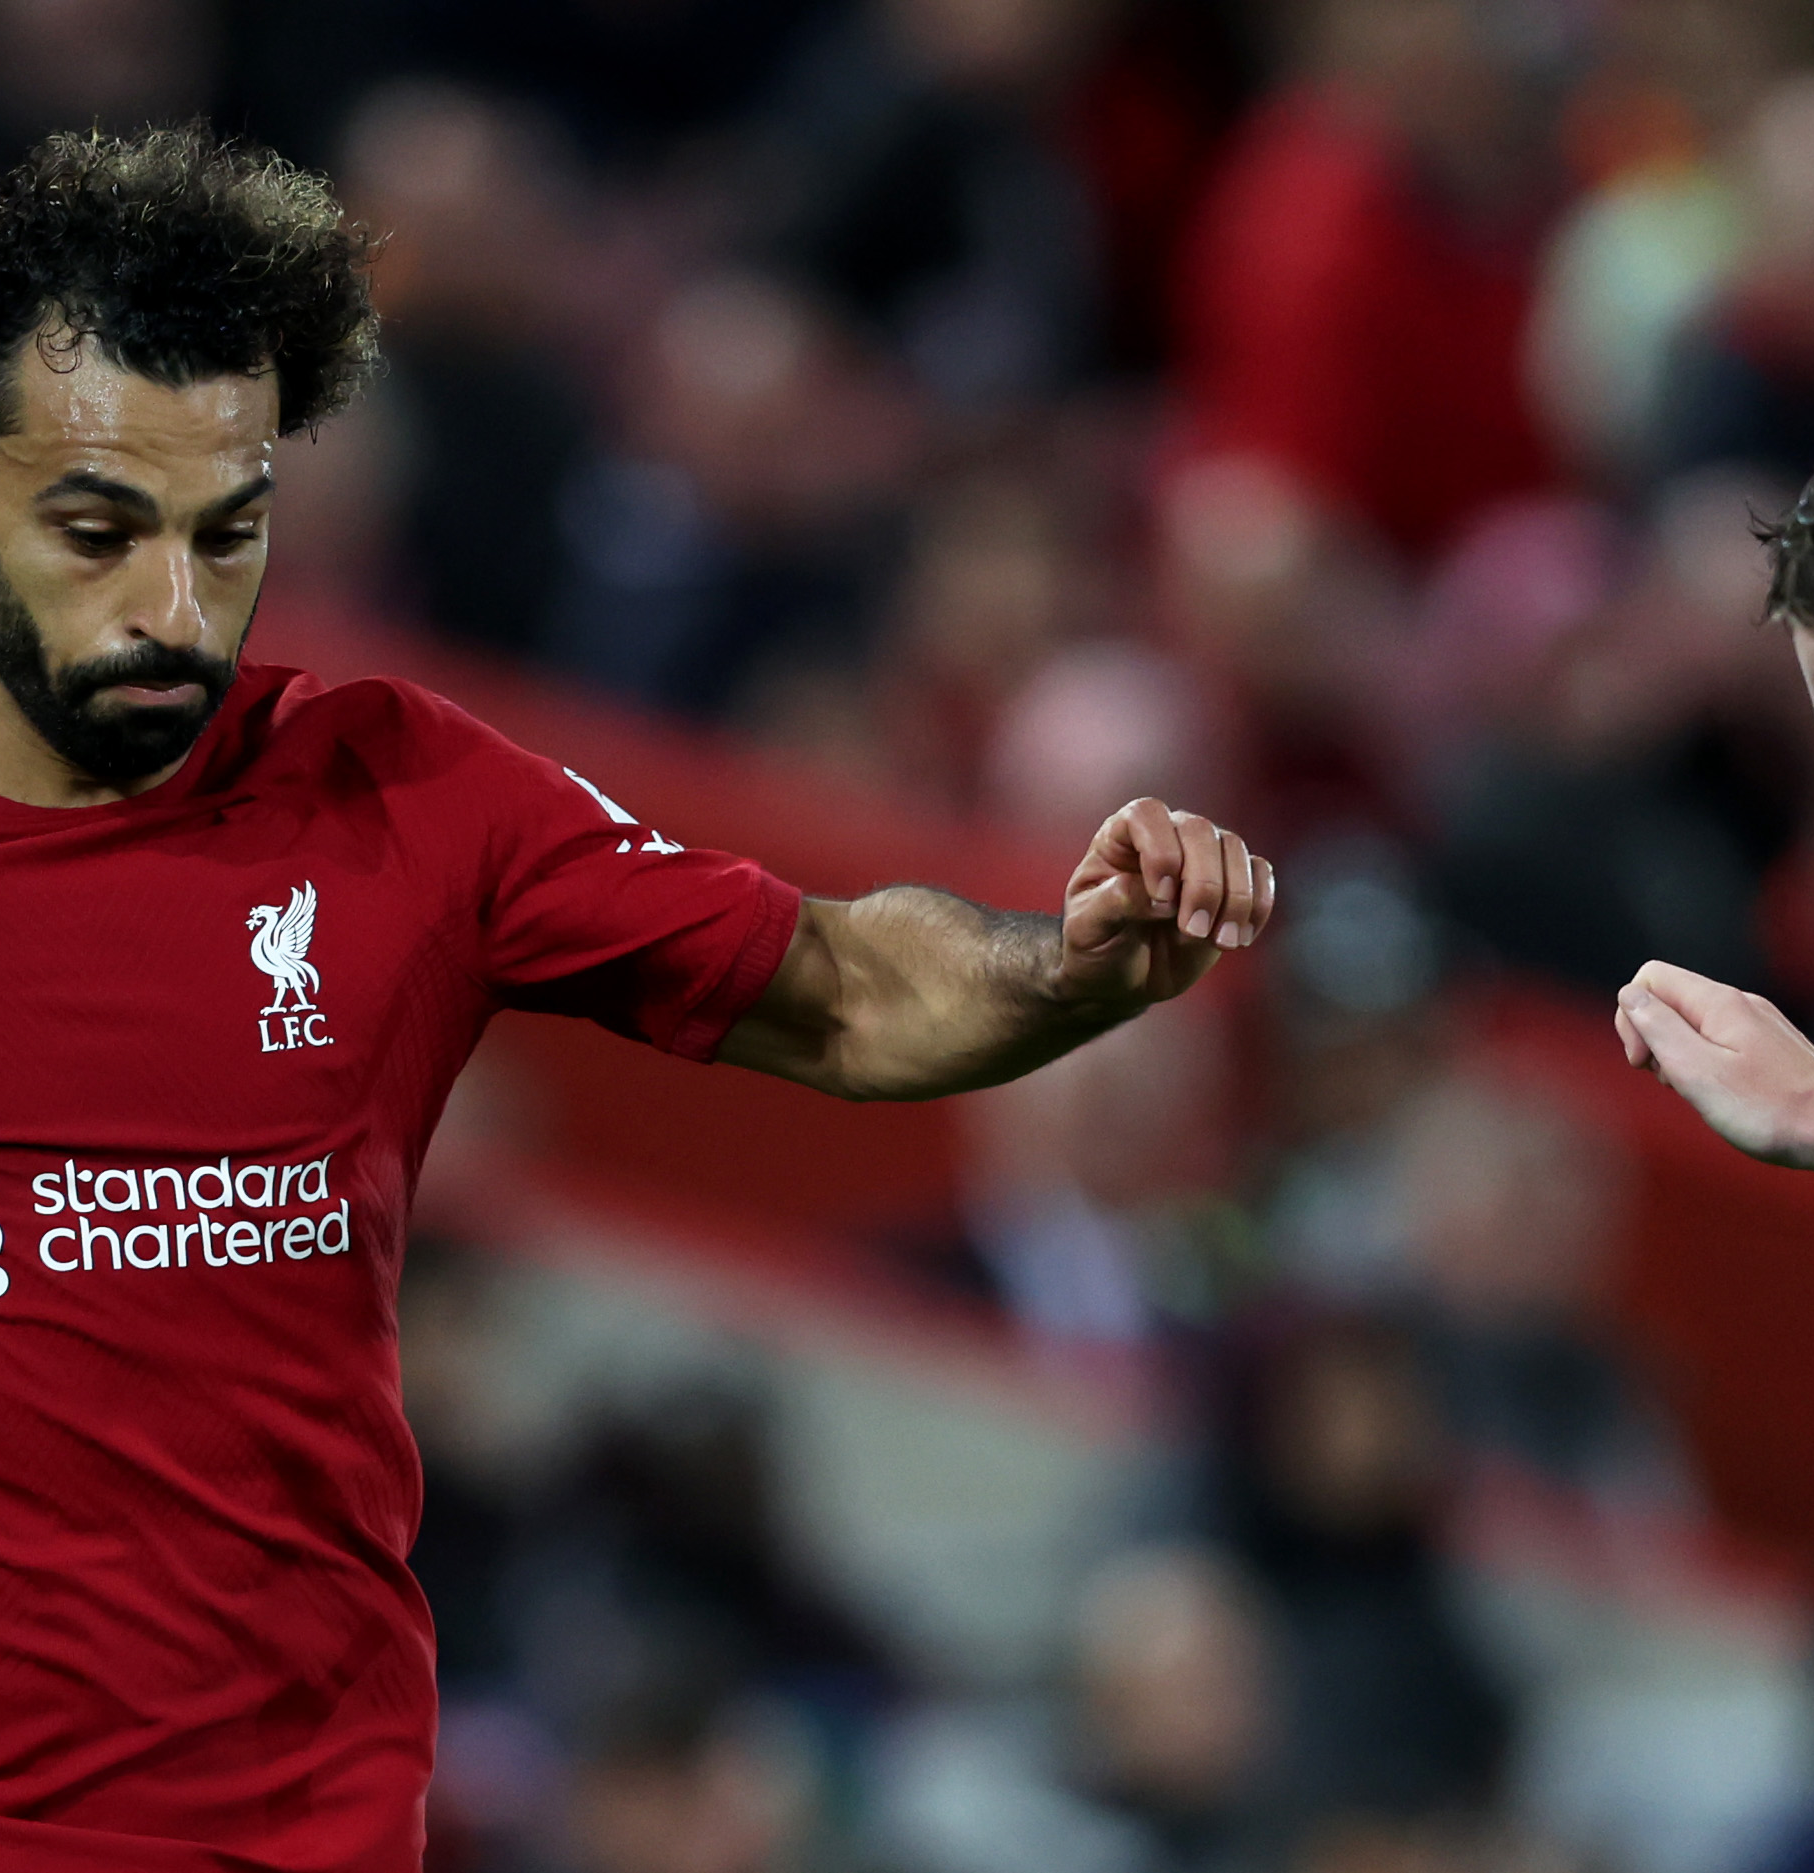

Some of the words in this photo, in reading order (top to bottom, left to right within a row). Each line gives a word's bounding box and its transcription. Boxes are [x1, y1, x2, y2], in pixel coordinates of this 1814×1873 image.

[258, 1013, 334, 1052] L.F.C.
[32, 1152, 334, 1215] standard
[39, 1198, 350, 1272] chartered
